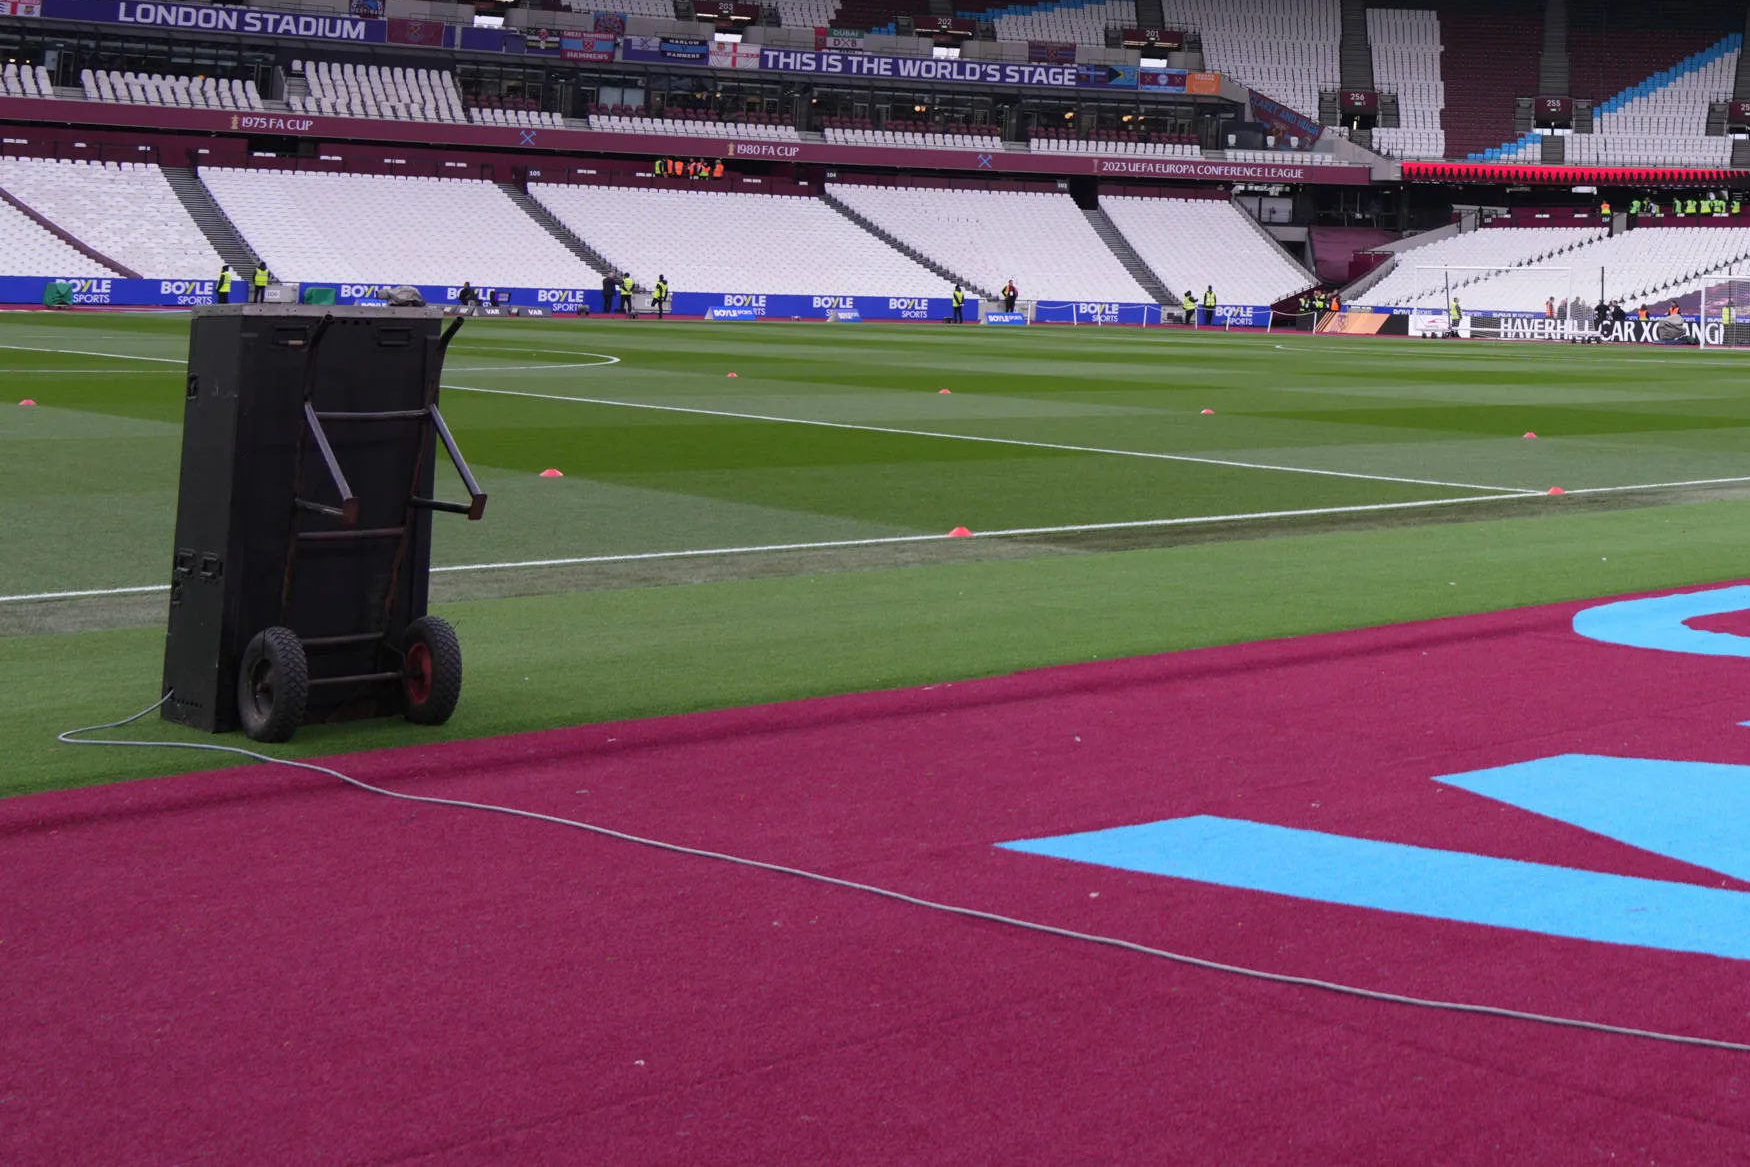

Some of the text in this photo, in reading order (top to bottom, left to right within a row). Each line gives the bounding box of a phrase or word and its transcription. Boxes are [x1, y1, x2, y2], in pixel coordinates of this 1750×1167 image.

[719, 2, 733, 10] 203
[118, 1, 366, 40] LONDON STADIUM
[1146, 30, 1159, 38] 201
[764, 51, 1077, 86] THIS IS THE WORLD'S STAGE
[1350, 93, 1365, 101] 256
[1547, 99, 1561, 107] 255
[242, 117, 313, 131] 1975 FA CUP
[737, 144, 799, 157] 1980 FA CUP
[1102, 162, 1304, 179] 2023 UEFA EUROPA CONFERENCE LEAGUE
[56, 279, 112, 293] OYLE
[160, 282, 213, 295] BOYLE
[73, 293, 110, 303] SPORTS
[177, 295, 213, 305] SPORTS
[538, 290, 584, 302] BOYLE
[724, 295, 766, 307] BOYLE
[813, 297, 853, 308] BOYLE
[889, 298, 928, 310] BOYLE
[1080, 302, 1118, 314] BOYLE
[713, 309, 737, 317] BOYLE
[902, 310, 928, 319] SPORTS
[1215, 306, 1253, 317] BOYLE
[988, 314, 1009, 322] BOYLE
[1092, 314, 1118, 323] SPORTS
[1226, 317, 1253, 325] SPORTS
[1500, 316, 1595, 341] HAVERHILL
[1600, 320, 1635, 342] CAR
